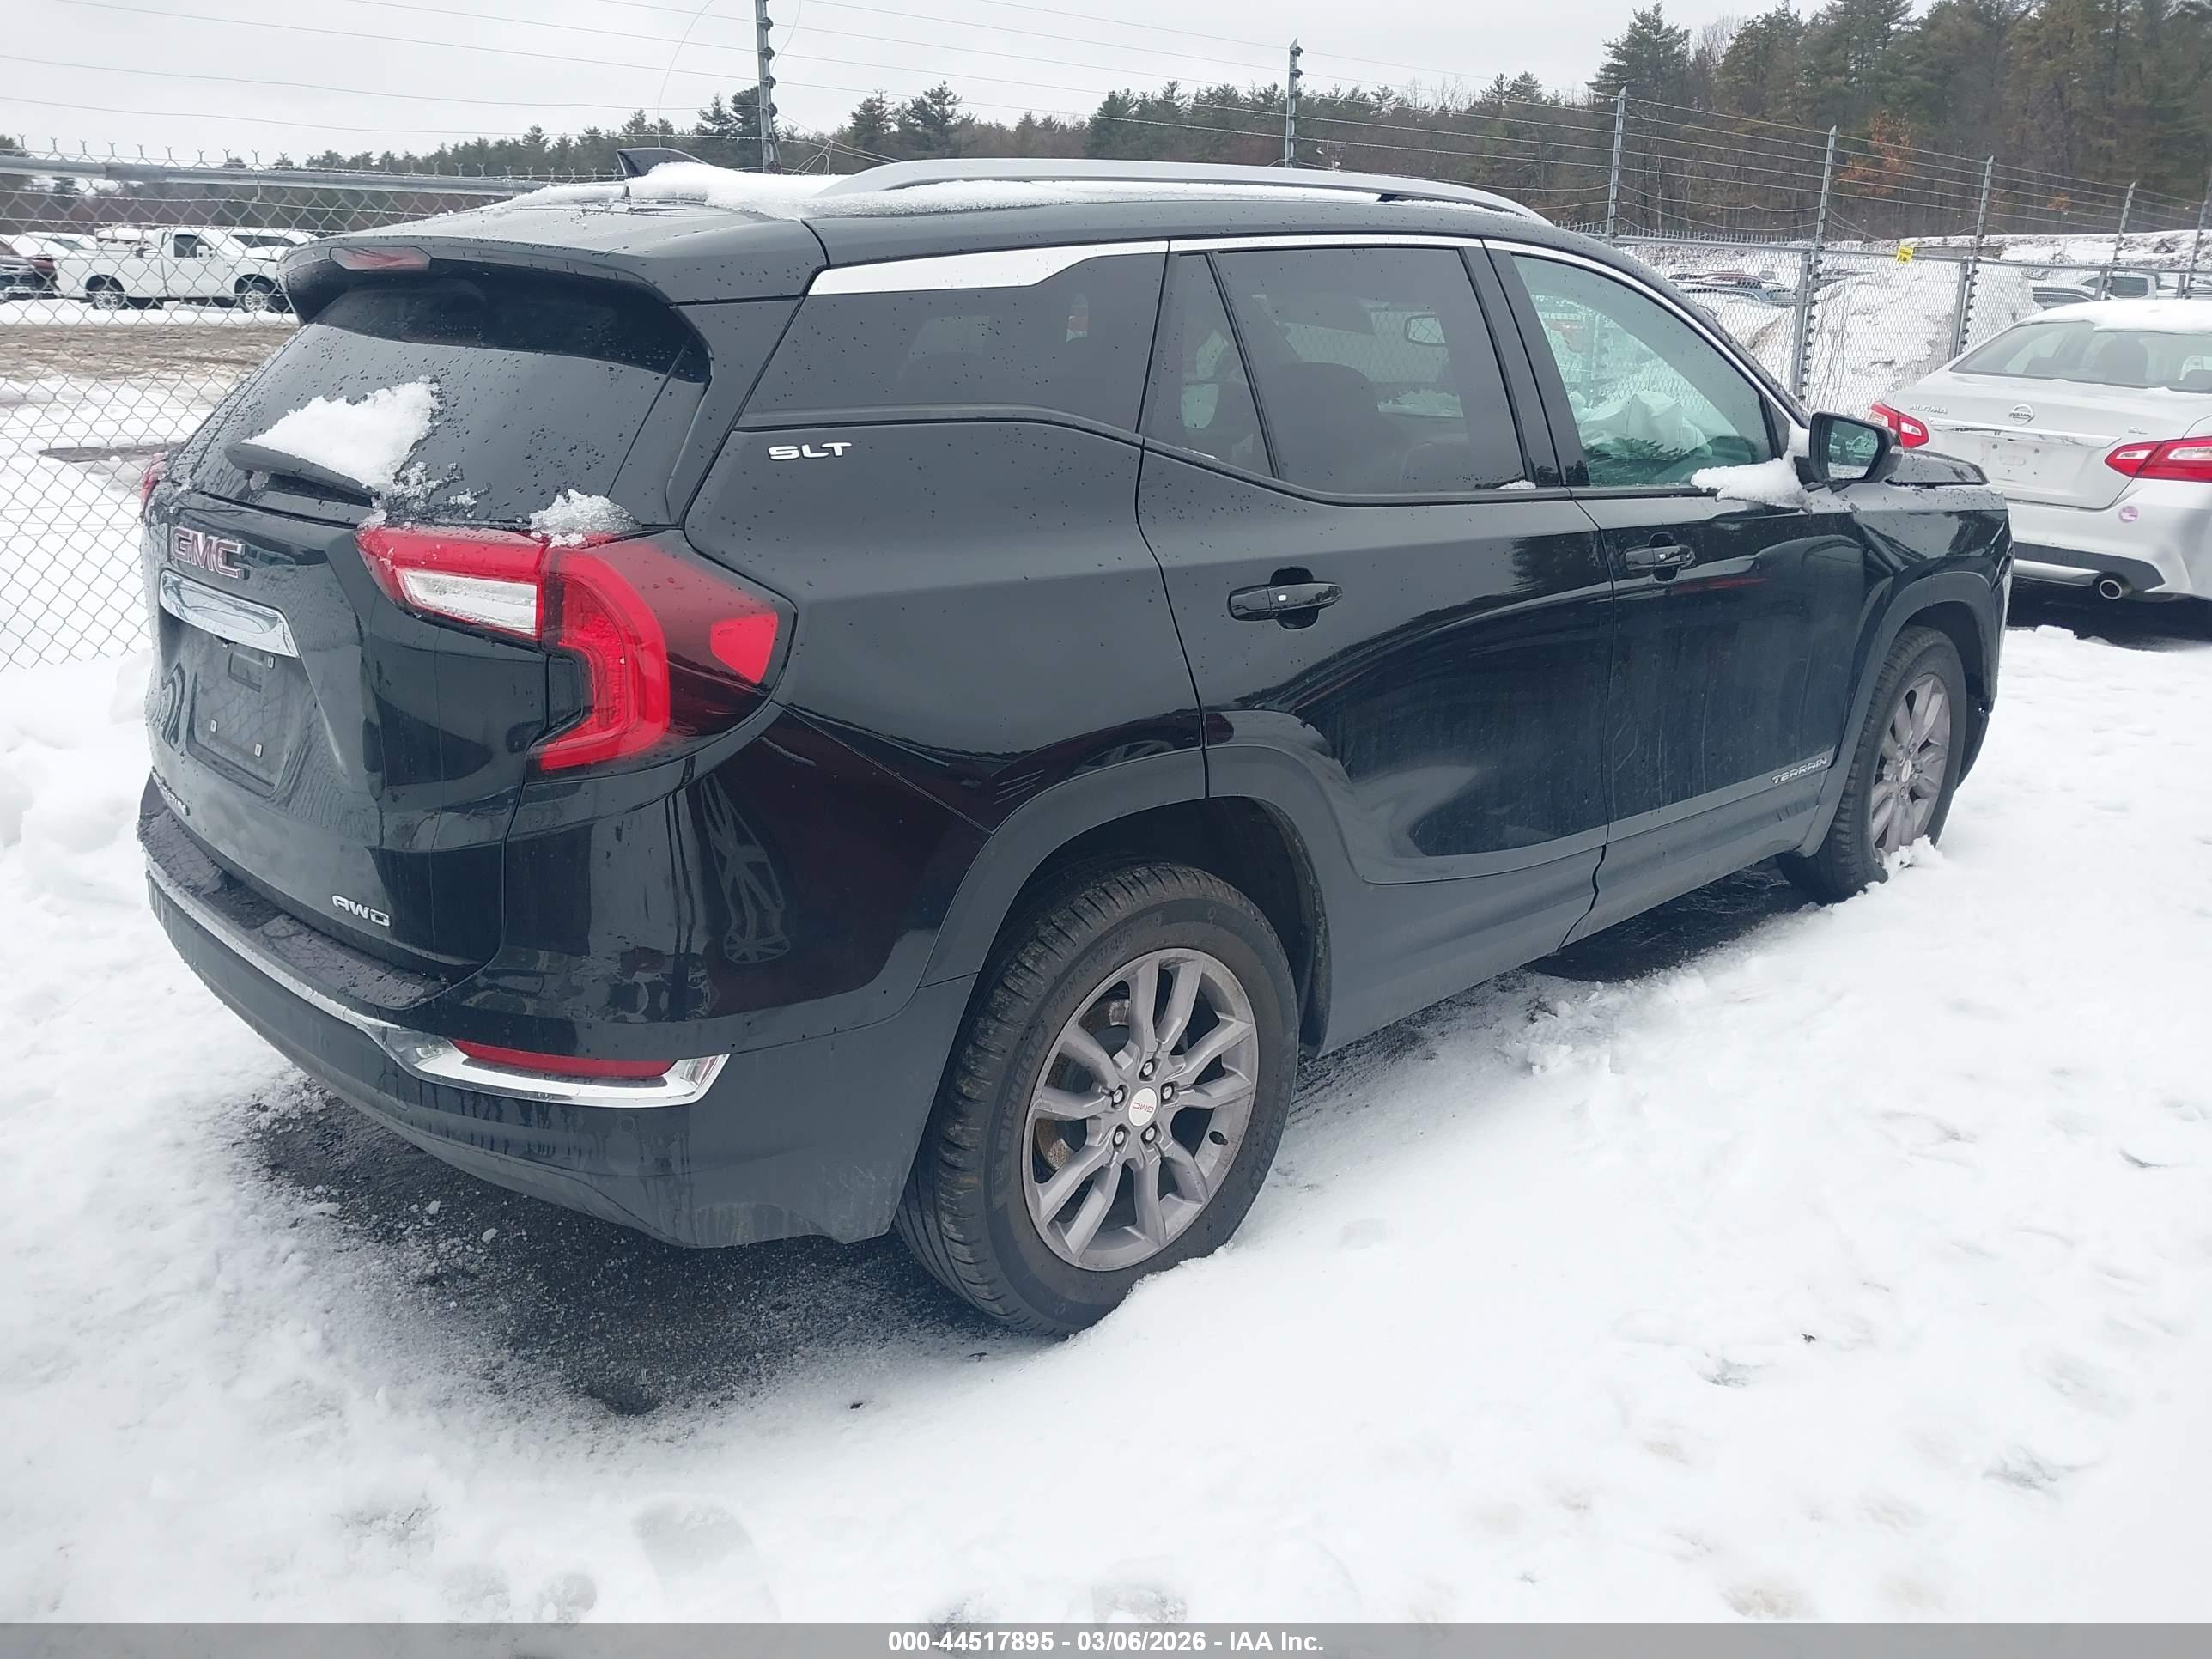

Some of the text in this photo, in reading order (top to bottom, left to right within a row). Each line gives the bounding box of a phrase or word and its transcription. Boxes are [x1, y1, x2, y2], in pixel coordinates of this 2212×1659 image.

[1908, 404, 1948, 415] ALTIMA
[768, 441, 853, 461] SLT
[173, 526, 249, 580] GMC
[1771, 757, 1828, 784] TERRAIN
[331, 895, 391, 927] AWD
[1133, 1101, 1154, 1113] GMC
